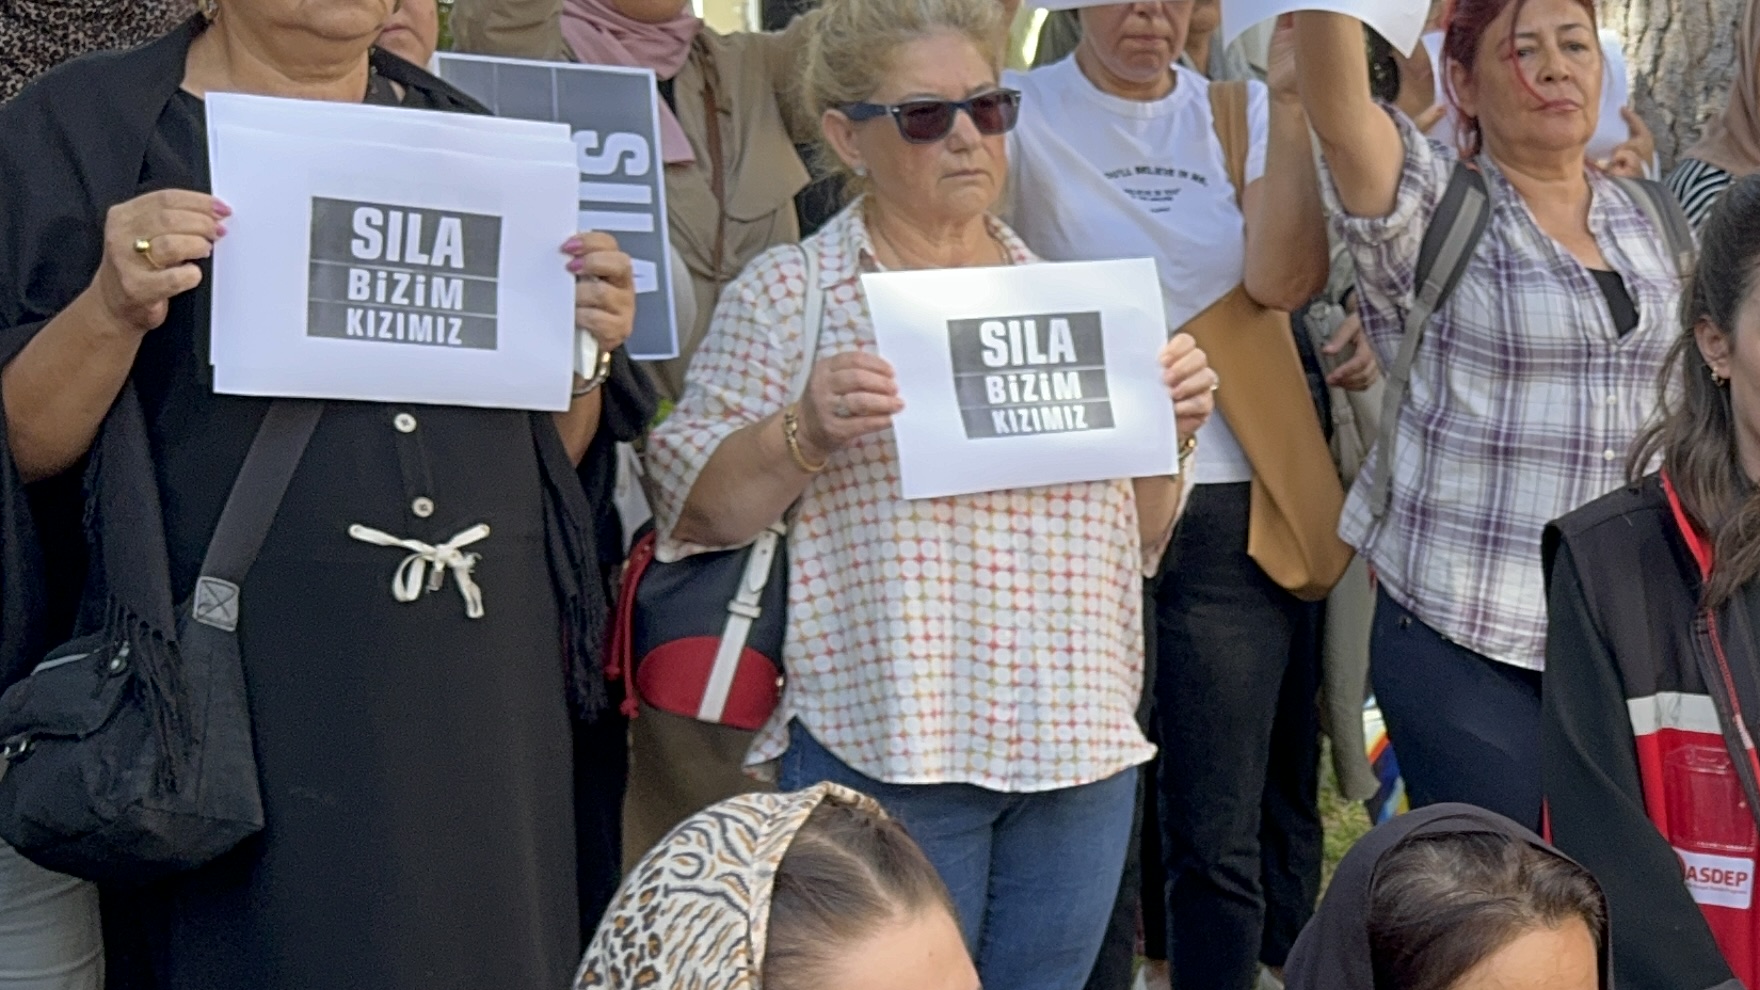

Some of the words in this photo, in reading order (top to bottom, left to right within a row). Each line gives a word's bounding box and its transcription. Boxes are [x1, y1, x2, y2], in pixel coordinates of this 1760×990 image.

[351, 206, 465, 268] SILA
[346, 307, 463, 345] KIZIMIZ
[979, 317, 1078, 368] SILA
[991, 404, 1089, 434] KIZIMIZ
[1686, 865, 1749, 887] ASDEP
